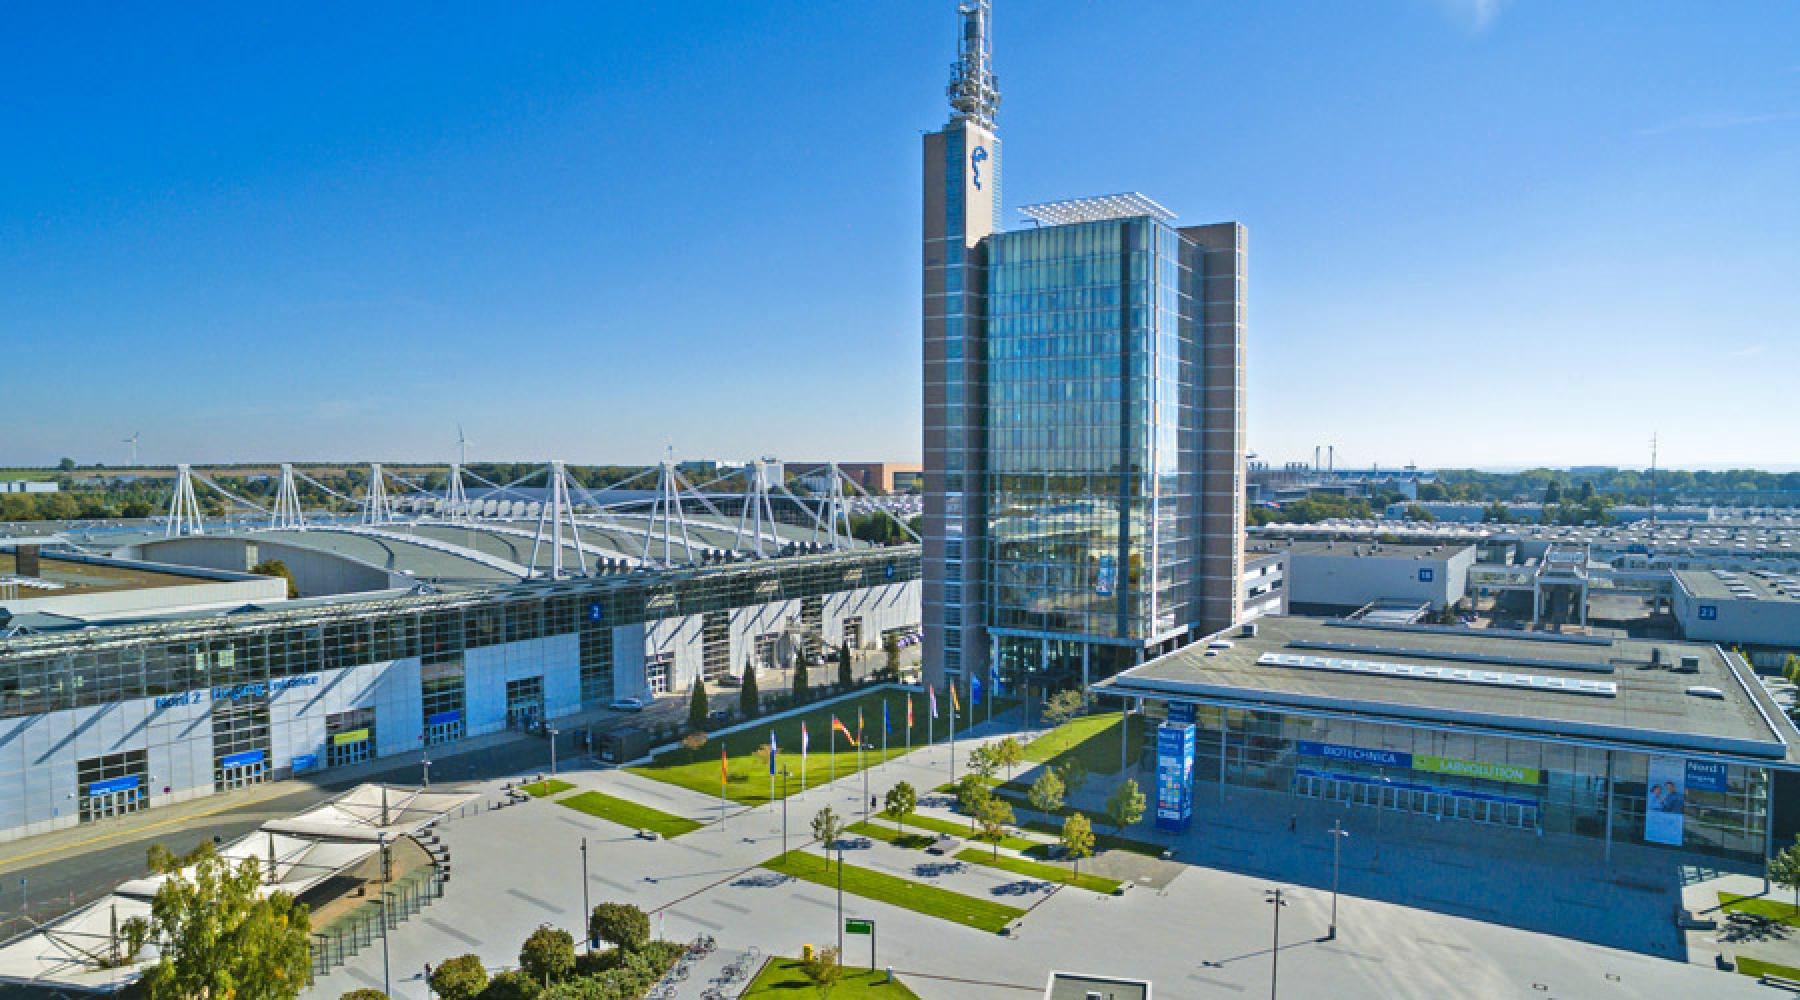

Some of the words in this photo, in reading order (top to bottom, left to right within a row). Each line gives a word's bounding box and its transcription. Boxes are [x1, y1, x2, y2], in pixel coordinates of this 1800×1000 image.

[1323, 745, 1396, 763] BIOTECHNICA
[1687, 761, 1717, 773] Nord
[1720, 764, 1725, 775] 1
